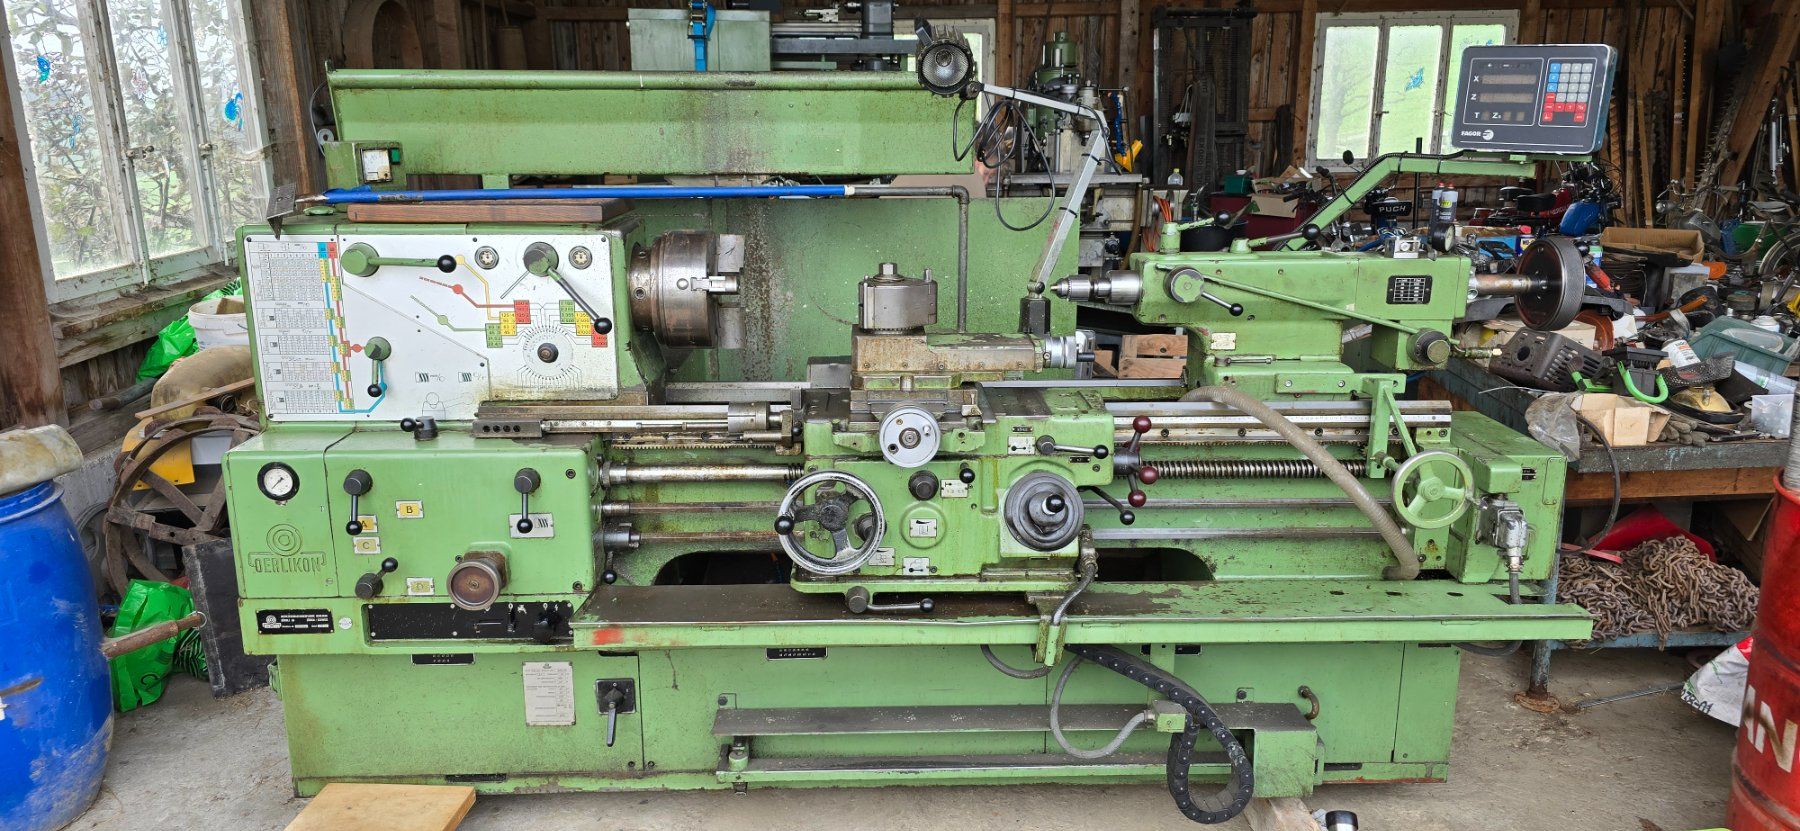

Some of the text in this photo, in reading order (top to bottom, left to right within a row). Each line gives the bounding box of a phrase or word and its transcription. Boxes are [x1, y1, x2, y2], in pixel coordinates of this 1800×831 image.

[1470, 93, 1477, 101] Z
[1379, 205, 1406, 213] PUCH
[406, 505, 413, 514] B
[361, 520, 368, 528] A
[362, 541, 370, 550] C
[254, 557, 321, 574] OERLIKON
